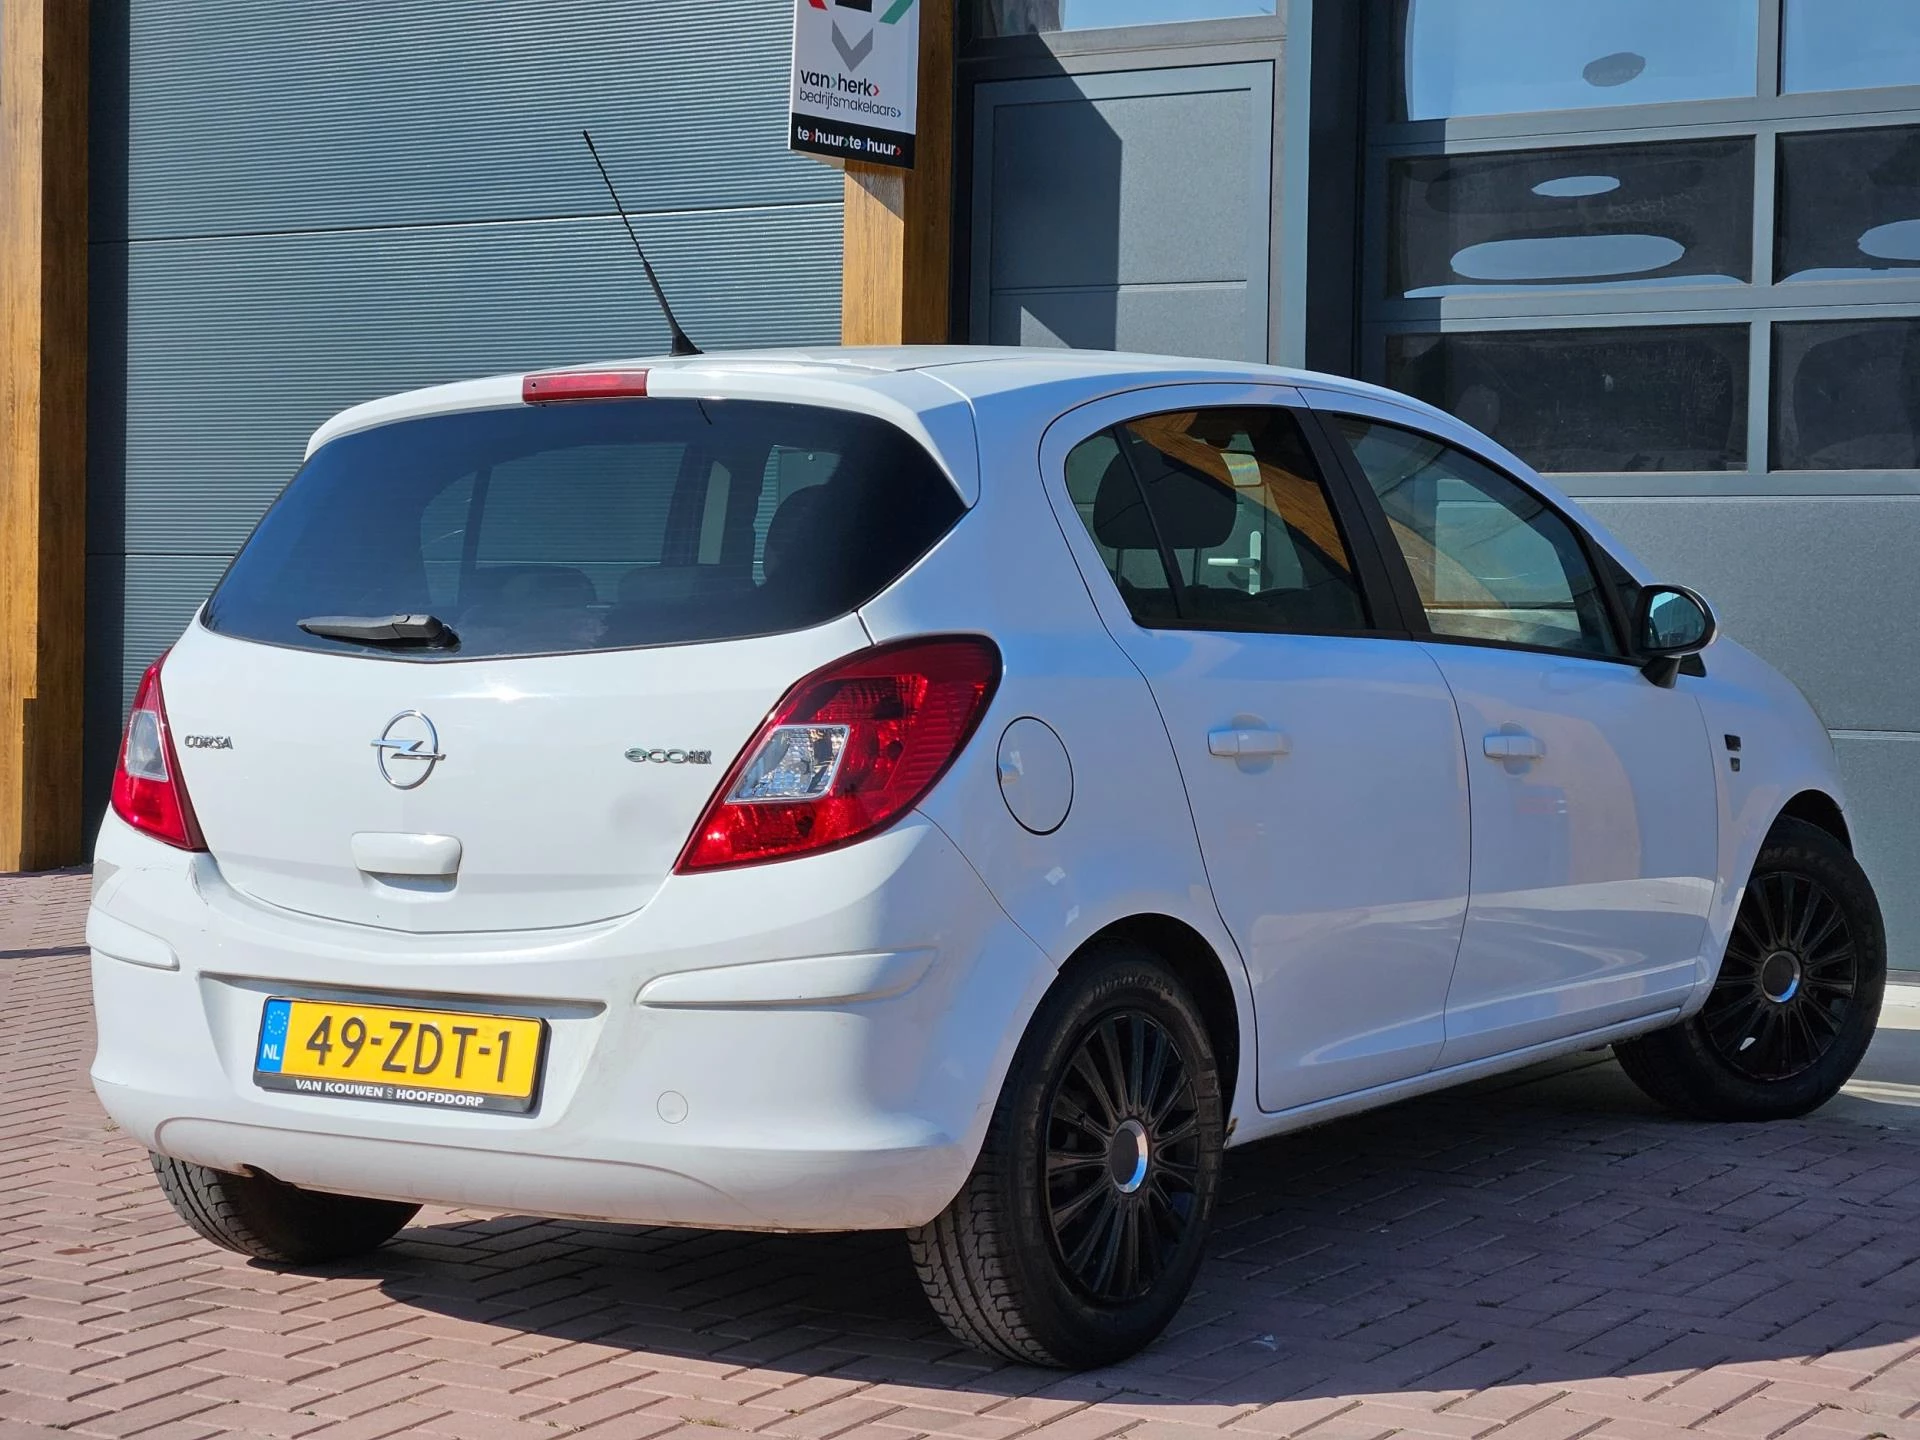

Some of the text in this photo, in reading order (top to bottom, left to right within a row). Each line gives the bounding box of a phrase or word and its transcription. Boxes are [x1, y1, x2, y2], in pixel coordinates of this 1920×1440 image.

[800, 87, 898, 118] bedrijfsmakelaars
[184, 735, 234, 750] CORSA
[263, 1043, 281, 1061] NL
[306, 1015, 512, 1083] 49-ZDT-1
[295, 1080, 484, 1107] VAN KOUWEN HOOFDDORP
